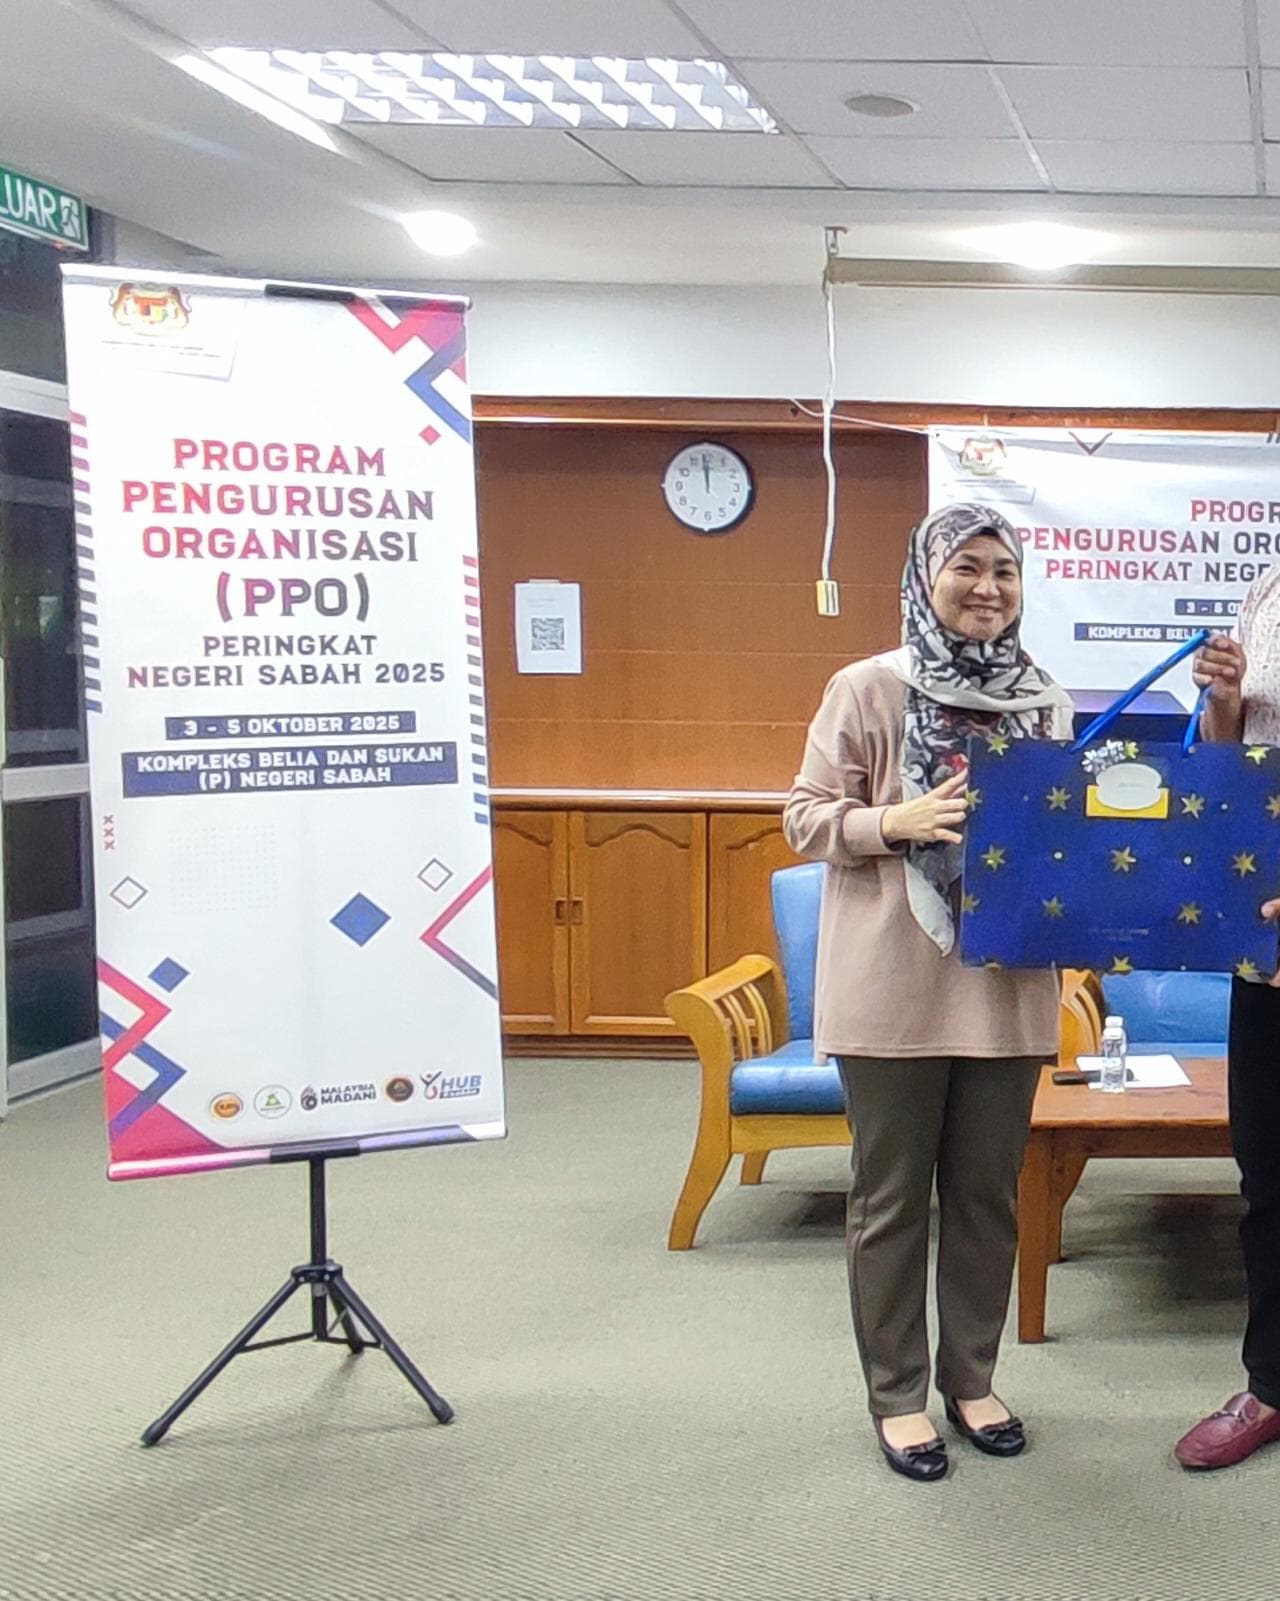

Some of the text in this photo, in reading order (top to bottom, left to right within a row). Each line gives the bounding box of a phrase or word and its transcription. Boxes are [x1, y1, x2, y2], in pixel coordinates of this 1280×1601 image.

[0, 174, 59, 233] UAR
[174, 438, 386, 477] PROGRAM
[122, 480, 434, 520] PENGURUSAN
[142, 526, 419, 562] ORGANISASI
[1015, 527, 1220, 554] PENGURUSAN
[1046, 559, 1192, 582] PERINGKAT
[217, 572, 369, 622] (PPO)
[1088, 626, 1161, 640] KOMPLEKS
[203, 635, 377, 657] PERINGKAT
[128, 663, 445, 688] NEGERI SABAH 2025
[184, 720, 197, 736] 3
[227, 719, 241, 736] 5
[247, 717, 343, 734] OKTOBER
[350, 716, 400, 732] 2025
[137, 747, 443, 773] KOMPLEKS BELIA DAN SUKAN
[199, 767, 391, 791] (P) NEGERI SABAH
[321, 1092, 376, 1105] MADANI
